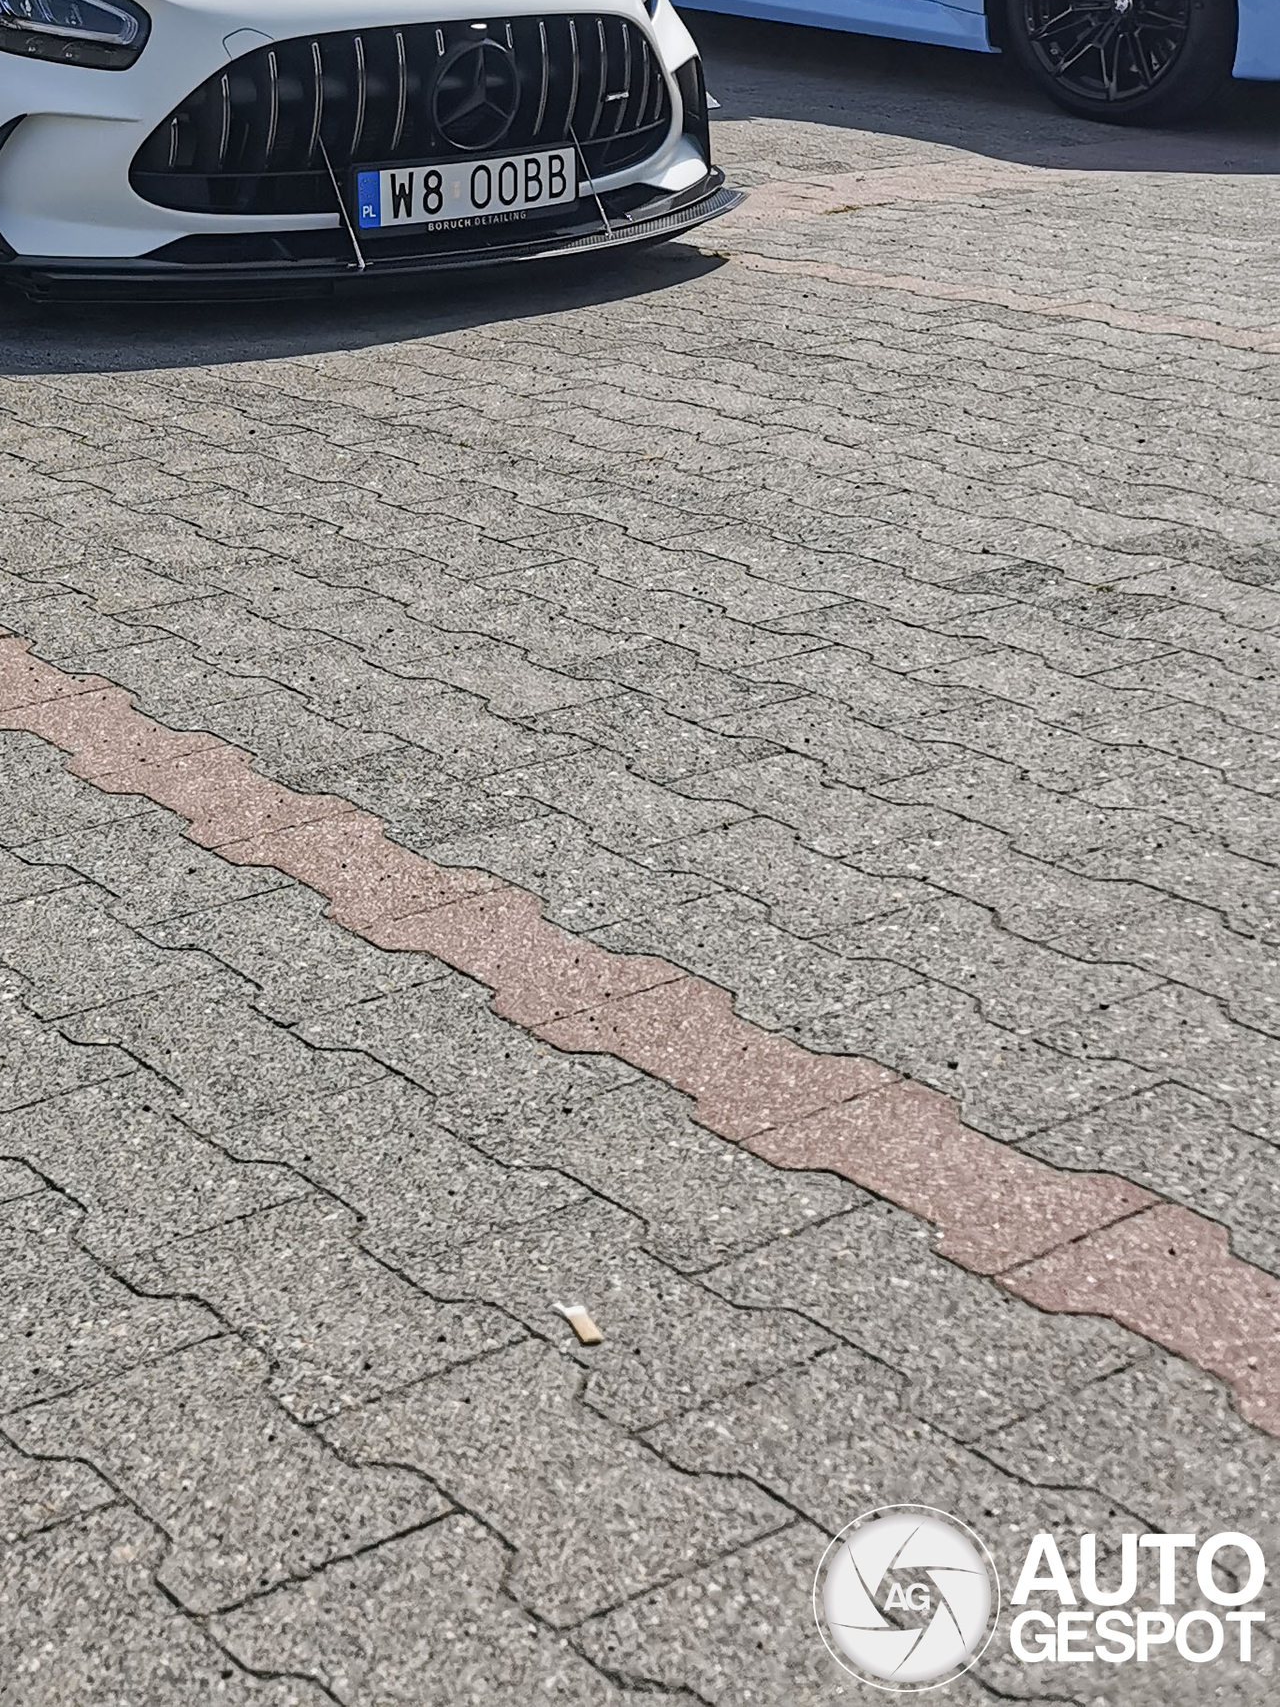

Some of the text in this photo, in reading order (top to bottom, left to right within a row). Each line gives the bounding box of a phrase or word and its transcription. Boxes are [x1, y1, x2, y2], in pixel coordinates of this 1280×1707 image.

[390, 169, 443, 219] W8
[362, 205, 377, 218] PL
[428, 211, 528, 232] BORUCH DETAILING
